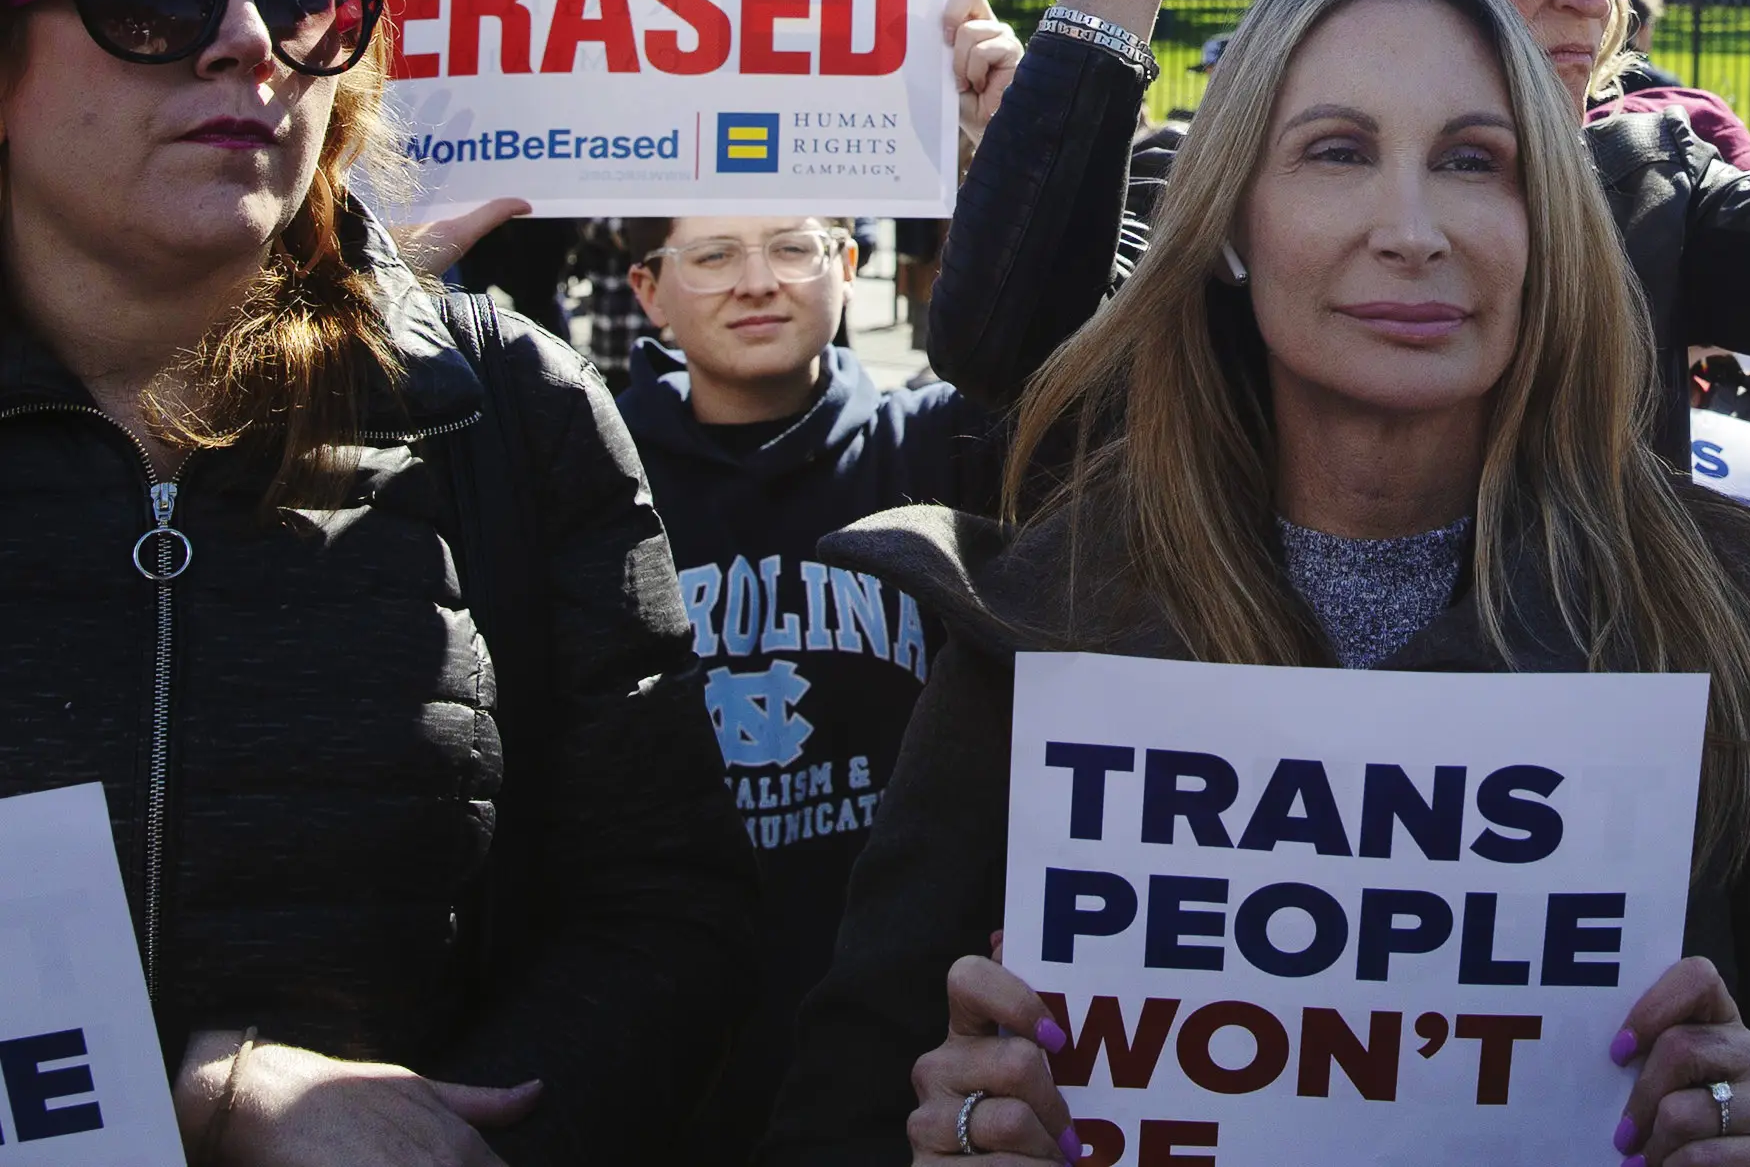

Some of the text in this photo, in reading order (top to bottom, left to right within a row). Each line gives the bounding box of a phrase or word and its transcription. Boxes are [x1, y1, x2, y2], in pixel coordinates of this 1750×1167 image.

[792, 138, 897, 154] RIGHTS
[793, 112, 898, 129] HUMAN
[792, 163, 896, 175] CAMPAIGN
[724, 755, 871, 810] ALISM &
[1045, 741, 1565, 864] TRANS
[1041, 867, 1626, 987] PEOPLE
[1036, 991, 1543, 1105] WON'T
